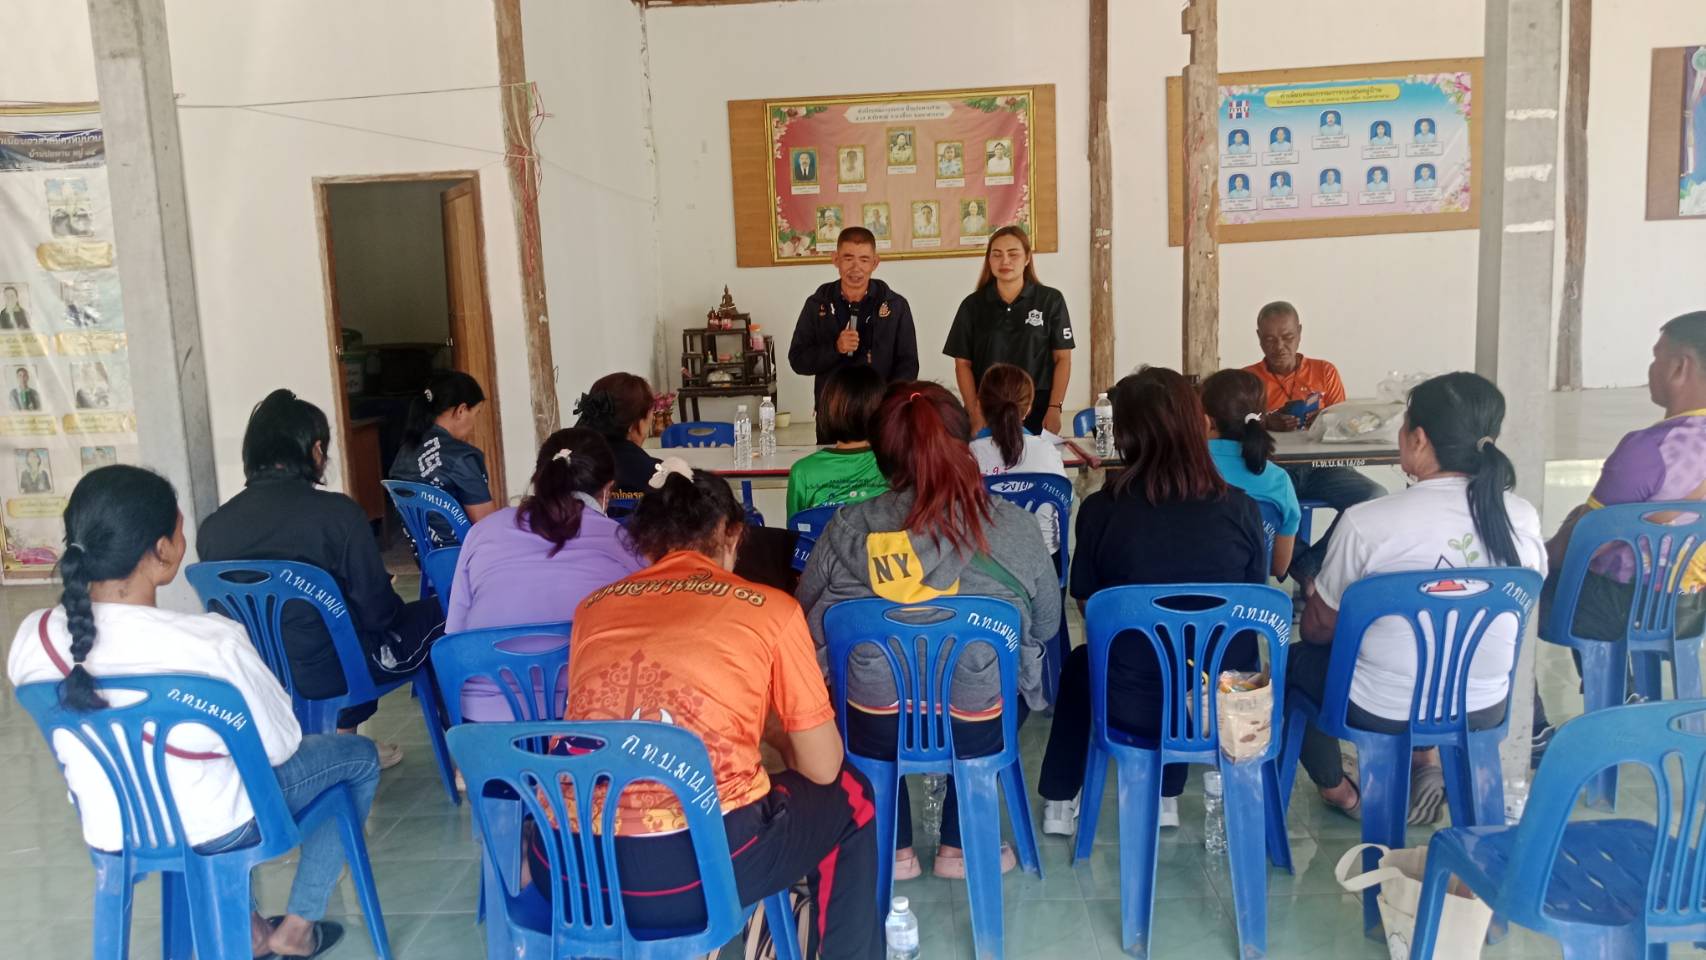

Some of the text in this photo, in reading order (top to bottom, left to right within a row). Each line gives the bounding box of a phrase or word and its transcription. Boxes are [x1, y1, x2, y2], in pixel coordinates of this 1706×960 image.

[1063, 327, 1073, 340] 5
[872, 552, 912, 584] NY
[732, 586, 767, 608] 68
